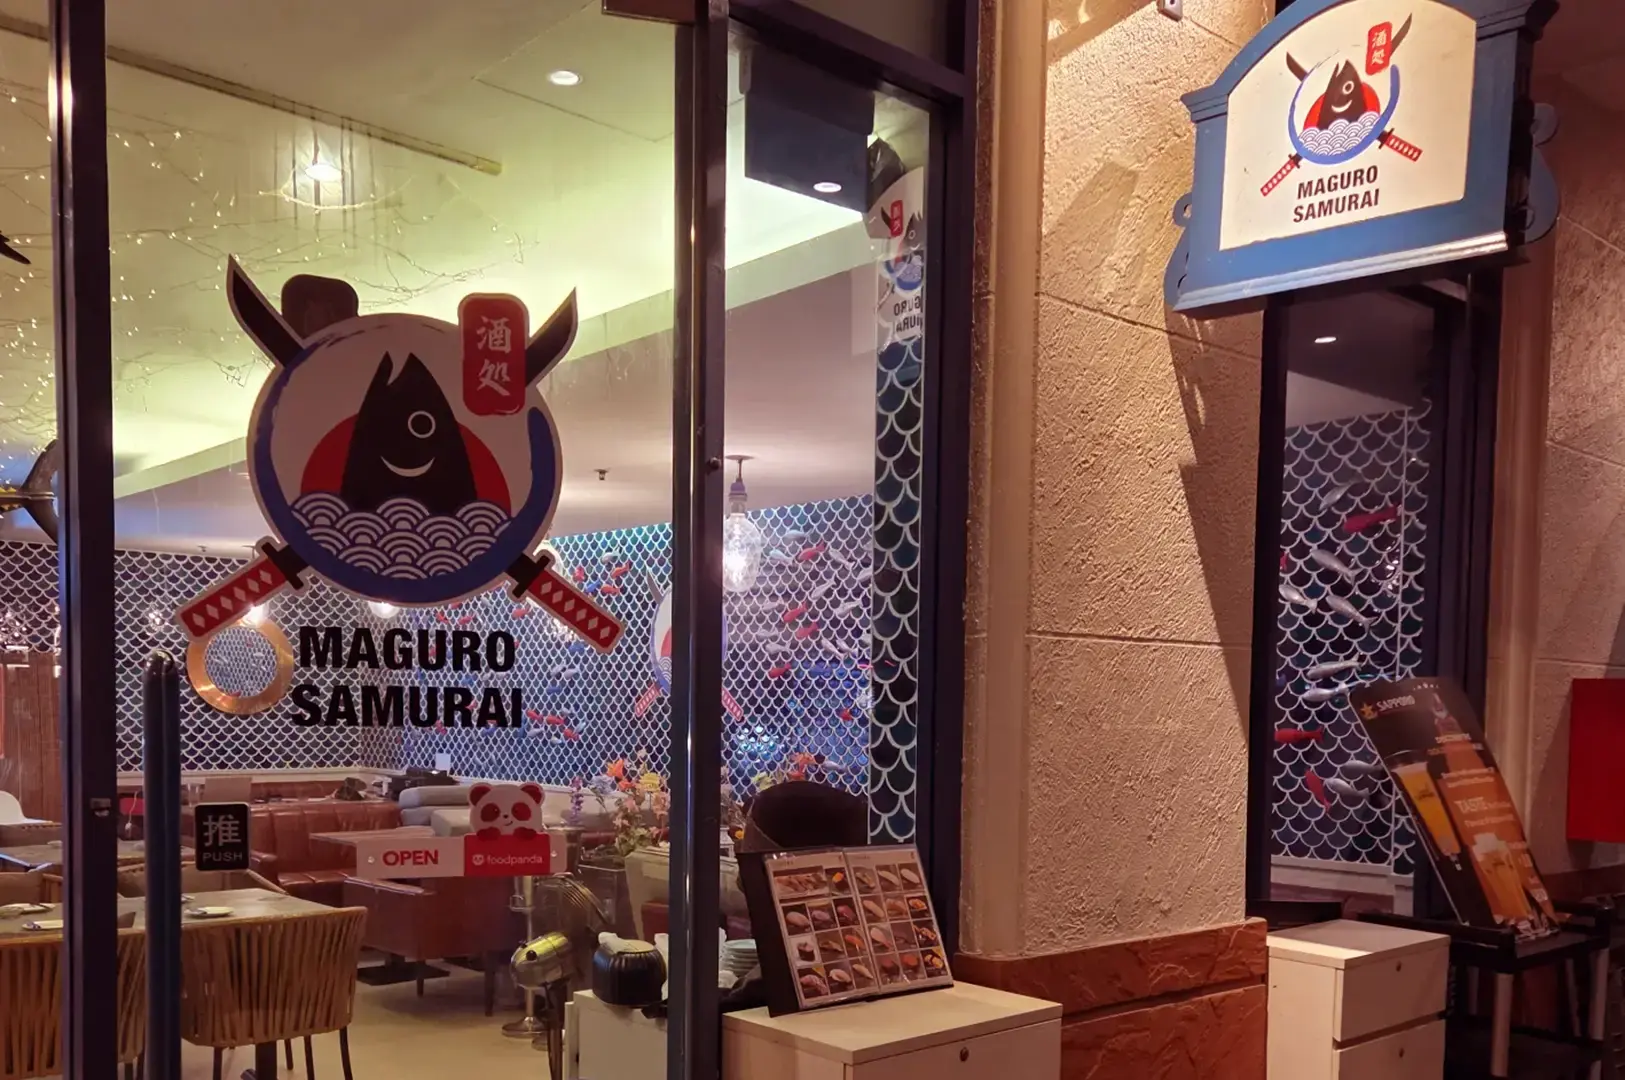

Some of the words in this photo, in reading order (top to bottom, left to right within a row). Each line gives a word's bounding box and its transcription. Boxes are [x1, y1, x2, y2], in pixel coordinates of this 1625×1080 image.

[1297, 165, 1378, 200] MAGURO
[1293, 188, 1380, 224] SAMURAI
[299, 626, 516, 672] MAGURO
[291, 684, 522, 728] SAMURAI
[203, 814, 241, 847] 推
[203, 852, 243, 863] PUSH
[383, 850, 439, 866] OPEN
[487, 852, 543, 866] foodpanda
